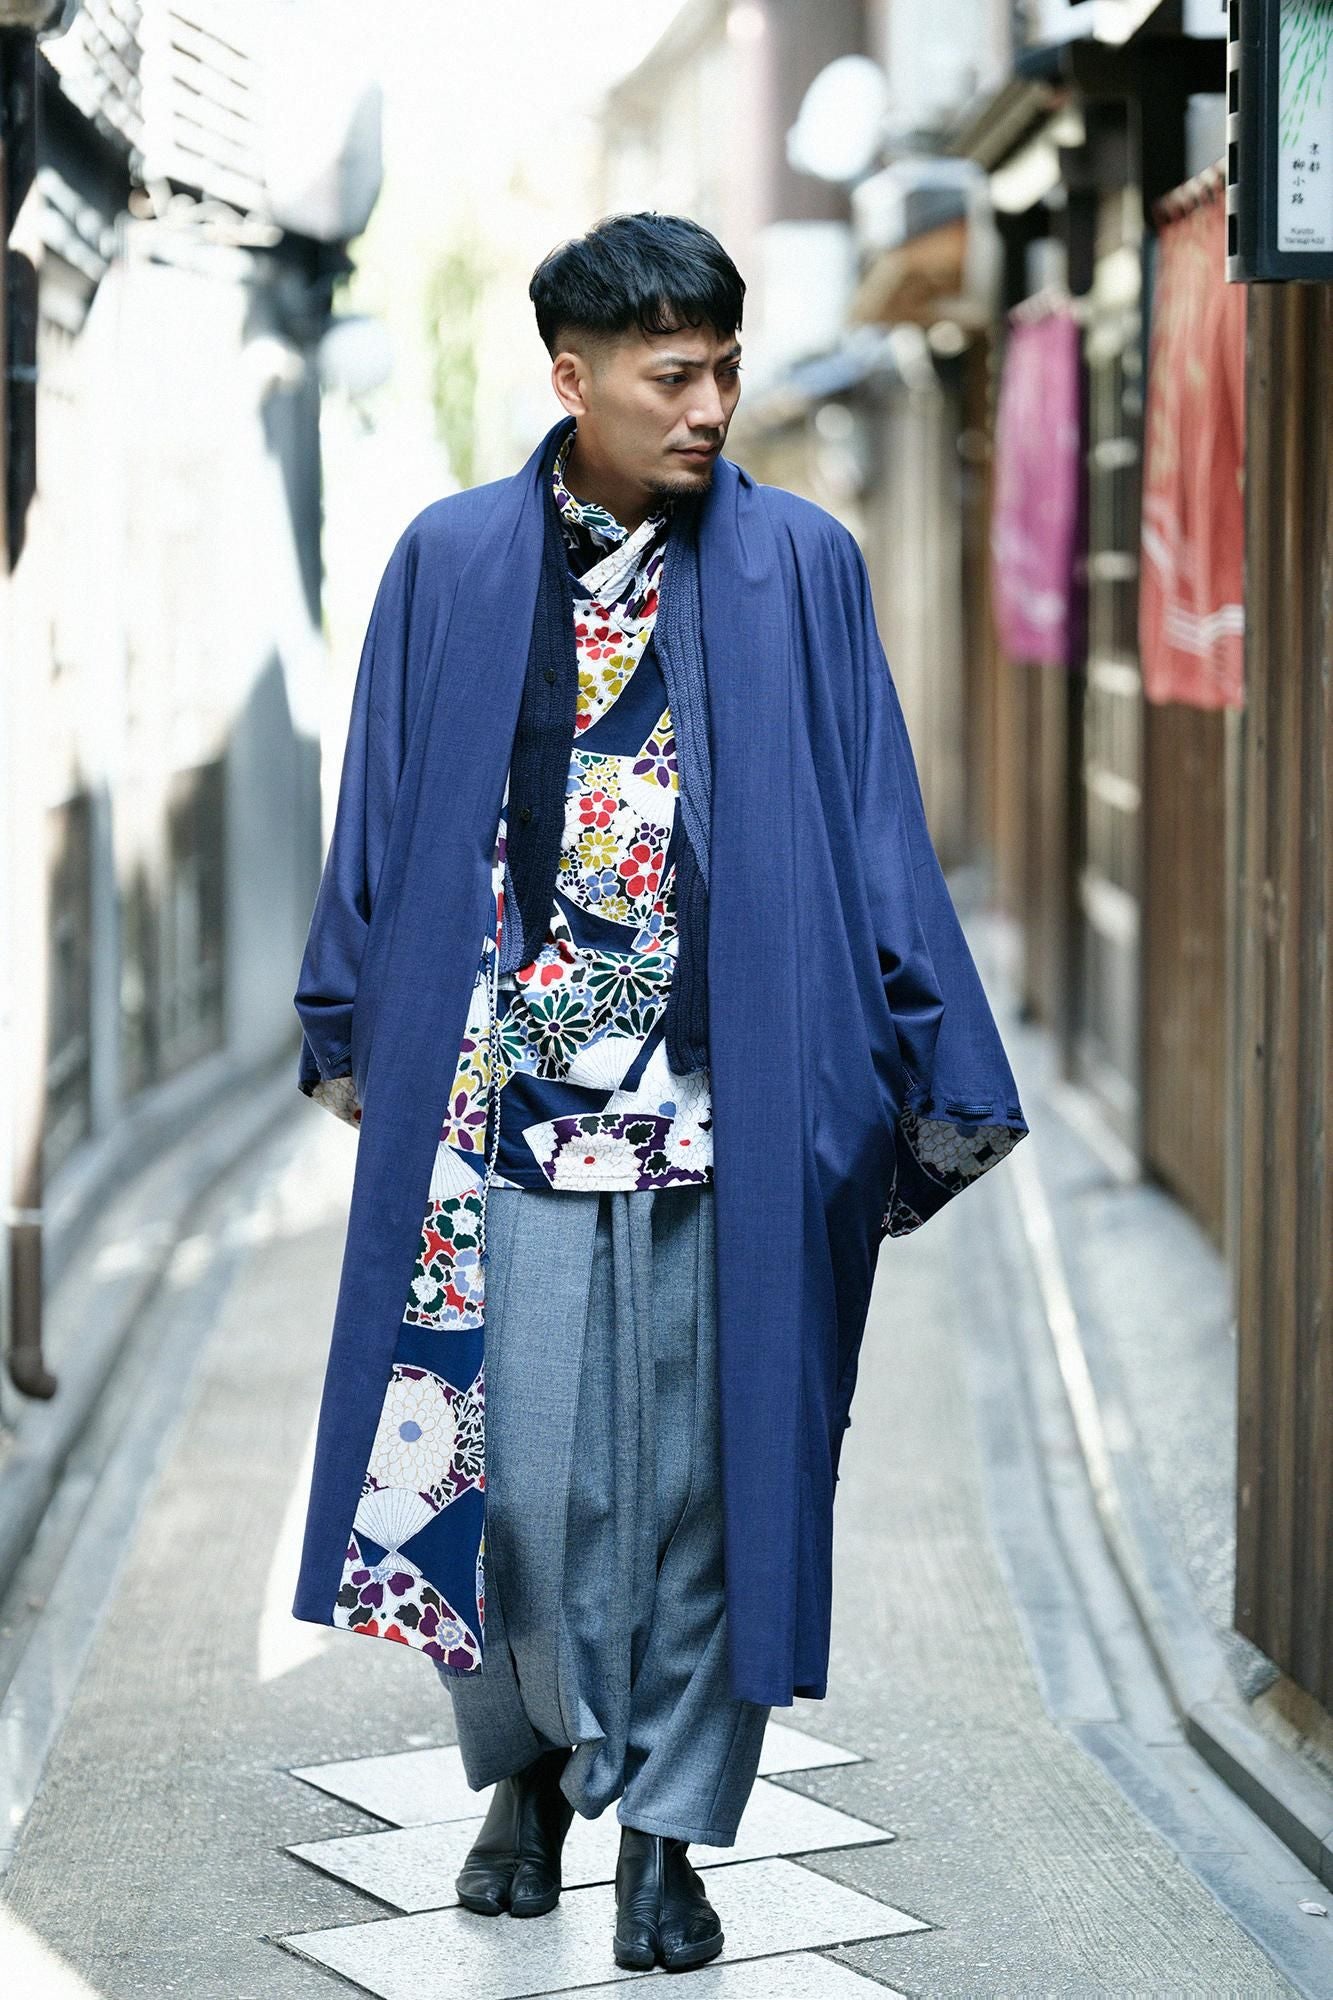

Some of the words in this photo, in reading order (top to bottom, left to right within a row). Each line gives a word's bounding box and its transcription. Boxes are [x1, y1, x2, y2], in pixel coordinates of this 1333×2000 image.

[1309, 142, 1320, 172] 京都
[1292, 159, 1306, 204] 柳小路
